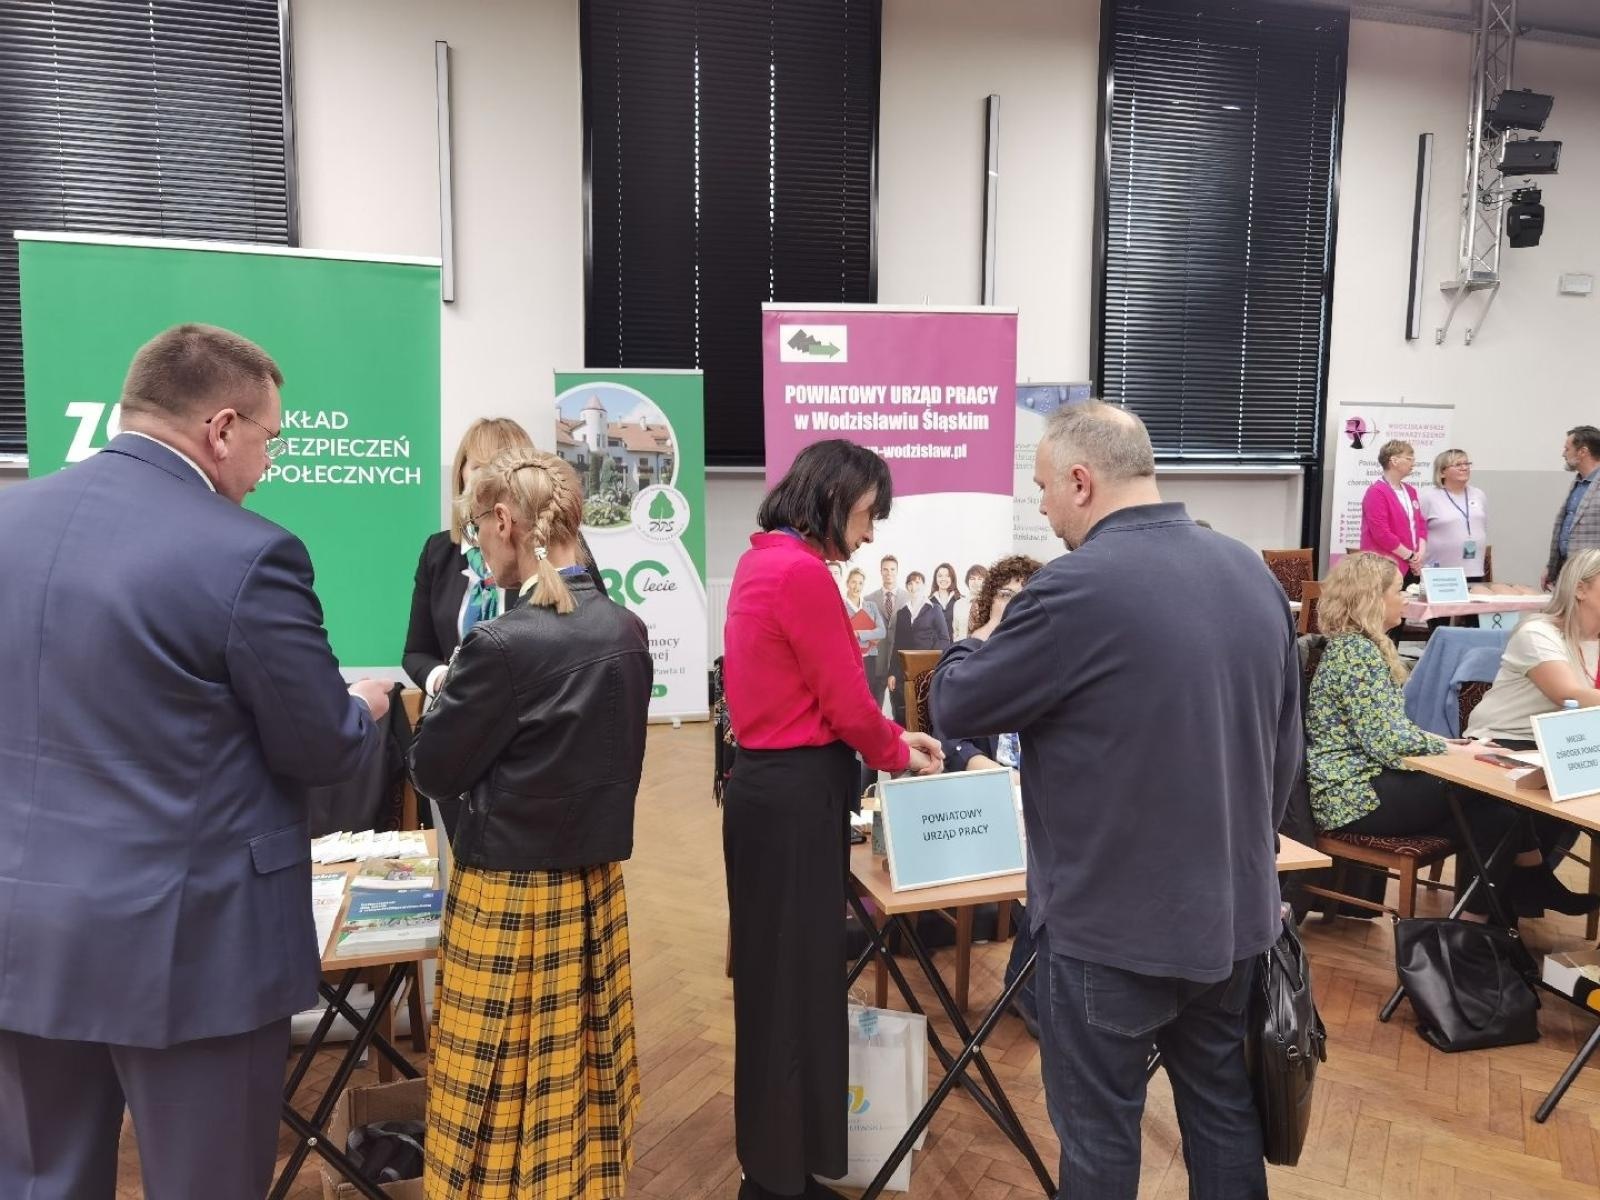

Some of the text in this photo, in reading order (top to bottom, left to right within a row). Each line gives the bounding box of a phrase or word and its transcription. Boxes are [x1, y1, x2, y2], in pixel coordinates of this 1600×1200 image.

[785, 385, 998, 408] POWIATOWY URZĄD PRACY
[794, 409, 989, 433] w Wodzisławiu Śląskim
[642, 577, 679, 592] lecie
[922, 809, 983, 824] POWIATOWY
[923, 825, 989, 842] URZĄD PRACY
